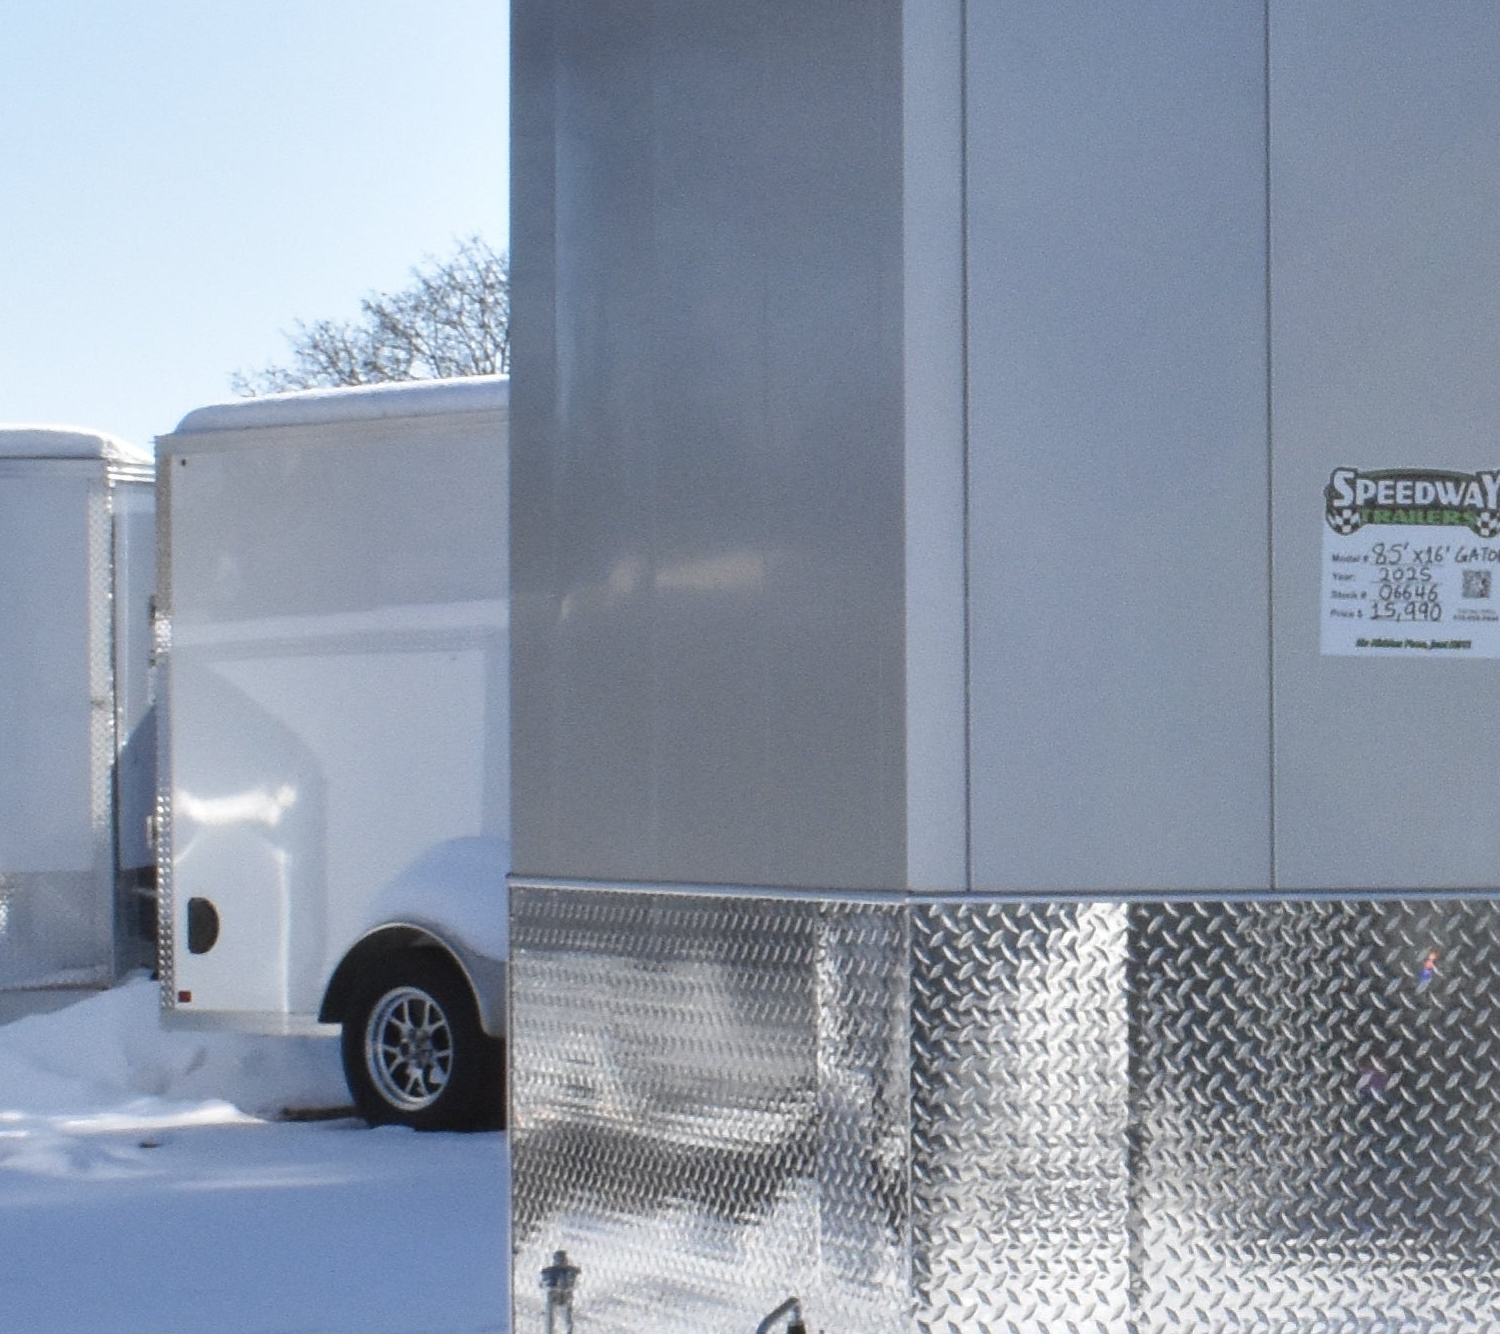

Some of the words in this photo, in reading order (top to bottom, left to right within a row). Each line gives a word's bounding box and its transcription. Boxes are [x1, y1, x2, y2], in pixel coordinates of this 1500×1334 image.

[1379, 566, 1432, 582] 2025
[1379, 583, 1438, 602] 06646
[1370, 601, 1442, 623] 15,990
